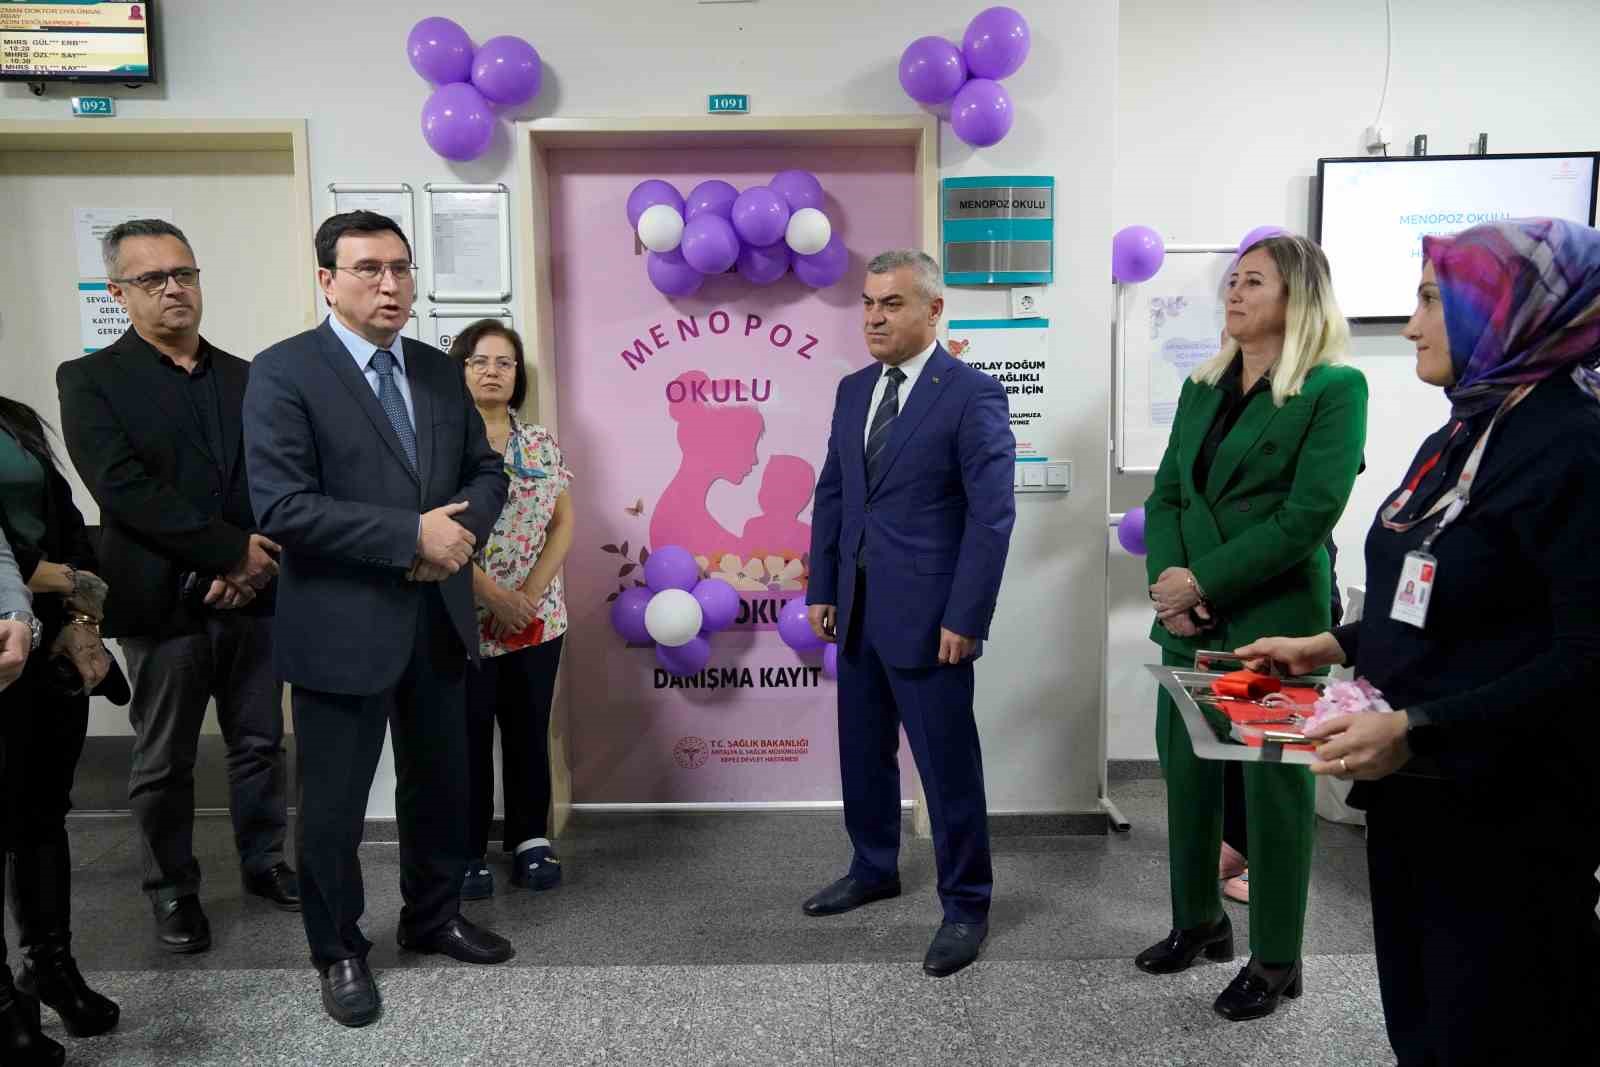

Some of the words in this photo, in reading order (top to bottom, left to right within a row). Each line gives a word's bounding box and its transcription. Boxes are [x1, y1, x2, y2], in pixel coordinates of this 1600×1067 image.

[712, 98, 744, 109] 1091
[959, 199, 1010, 209] MENOPOZ
[1012, 199, 1046, 209] OKULU
[1399, 213, 1464, 225] MENOPOZ
[620, 310, 820, 371] MENOPOZ
[1005, 359, 1046, 370] DOĞUM
[665, 379, 771, 404] OKULU
[1022, 384, 1044, 395] İÇİN
[653, 667, 754, 691] DANIŞMA
[759, 667, 822, 688] KAYIT
[727, 738, 759, 748] SAĞLIK
[760, 737, 809, 748] BAKANLIĞI
